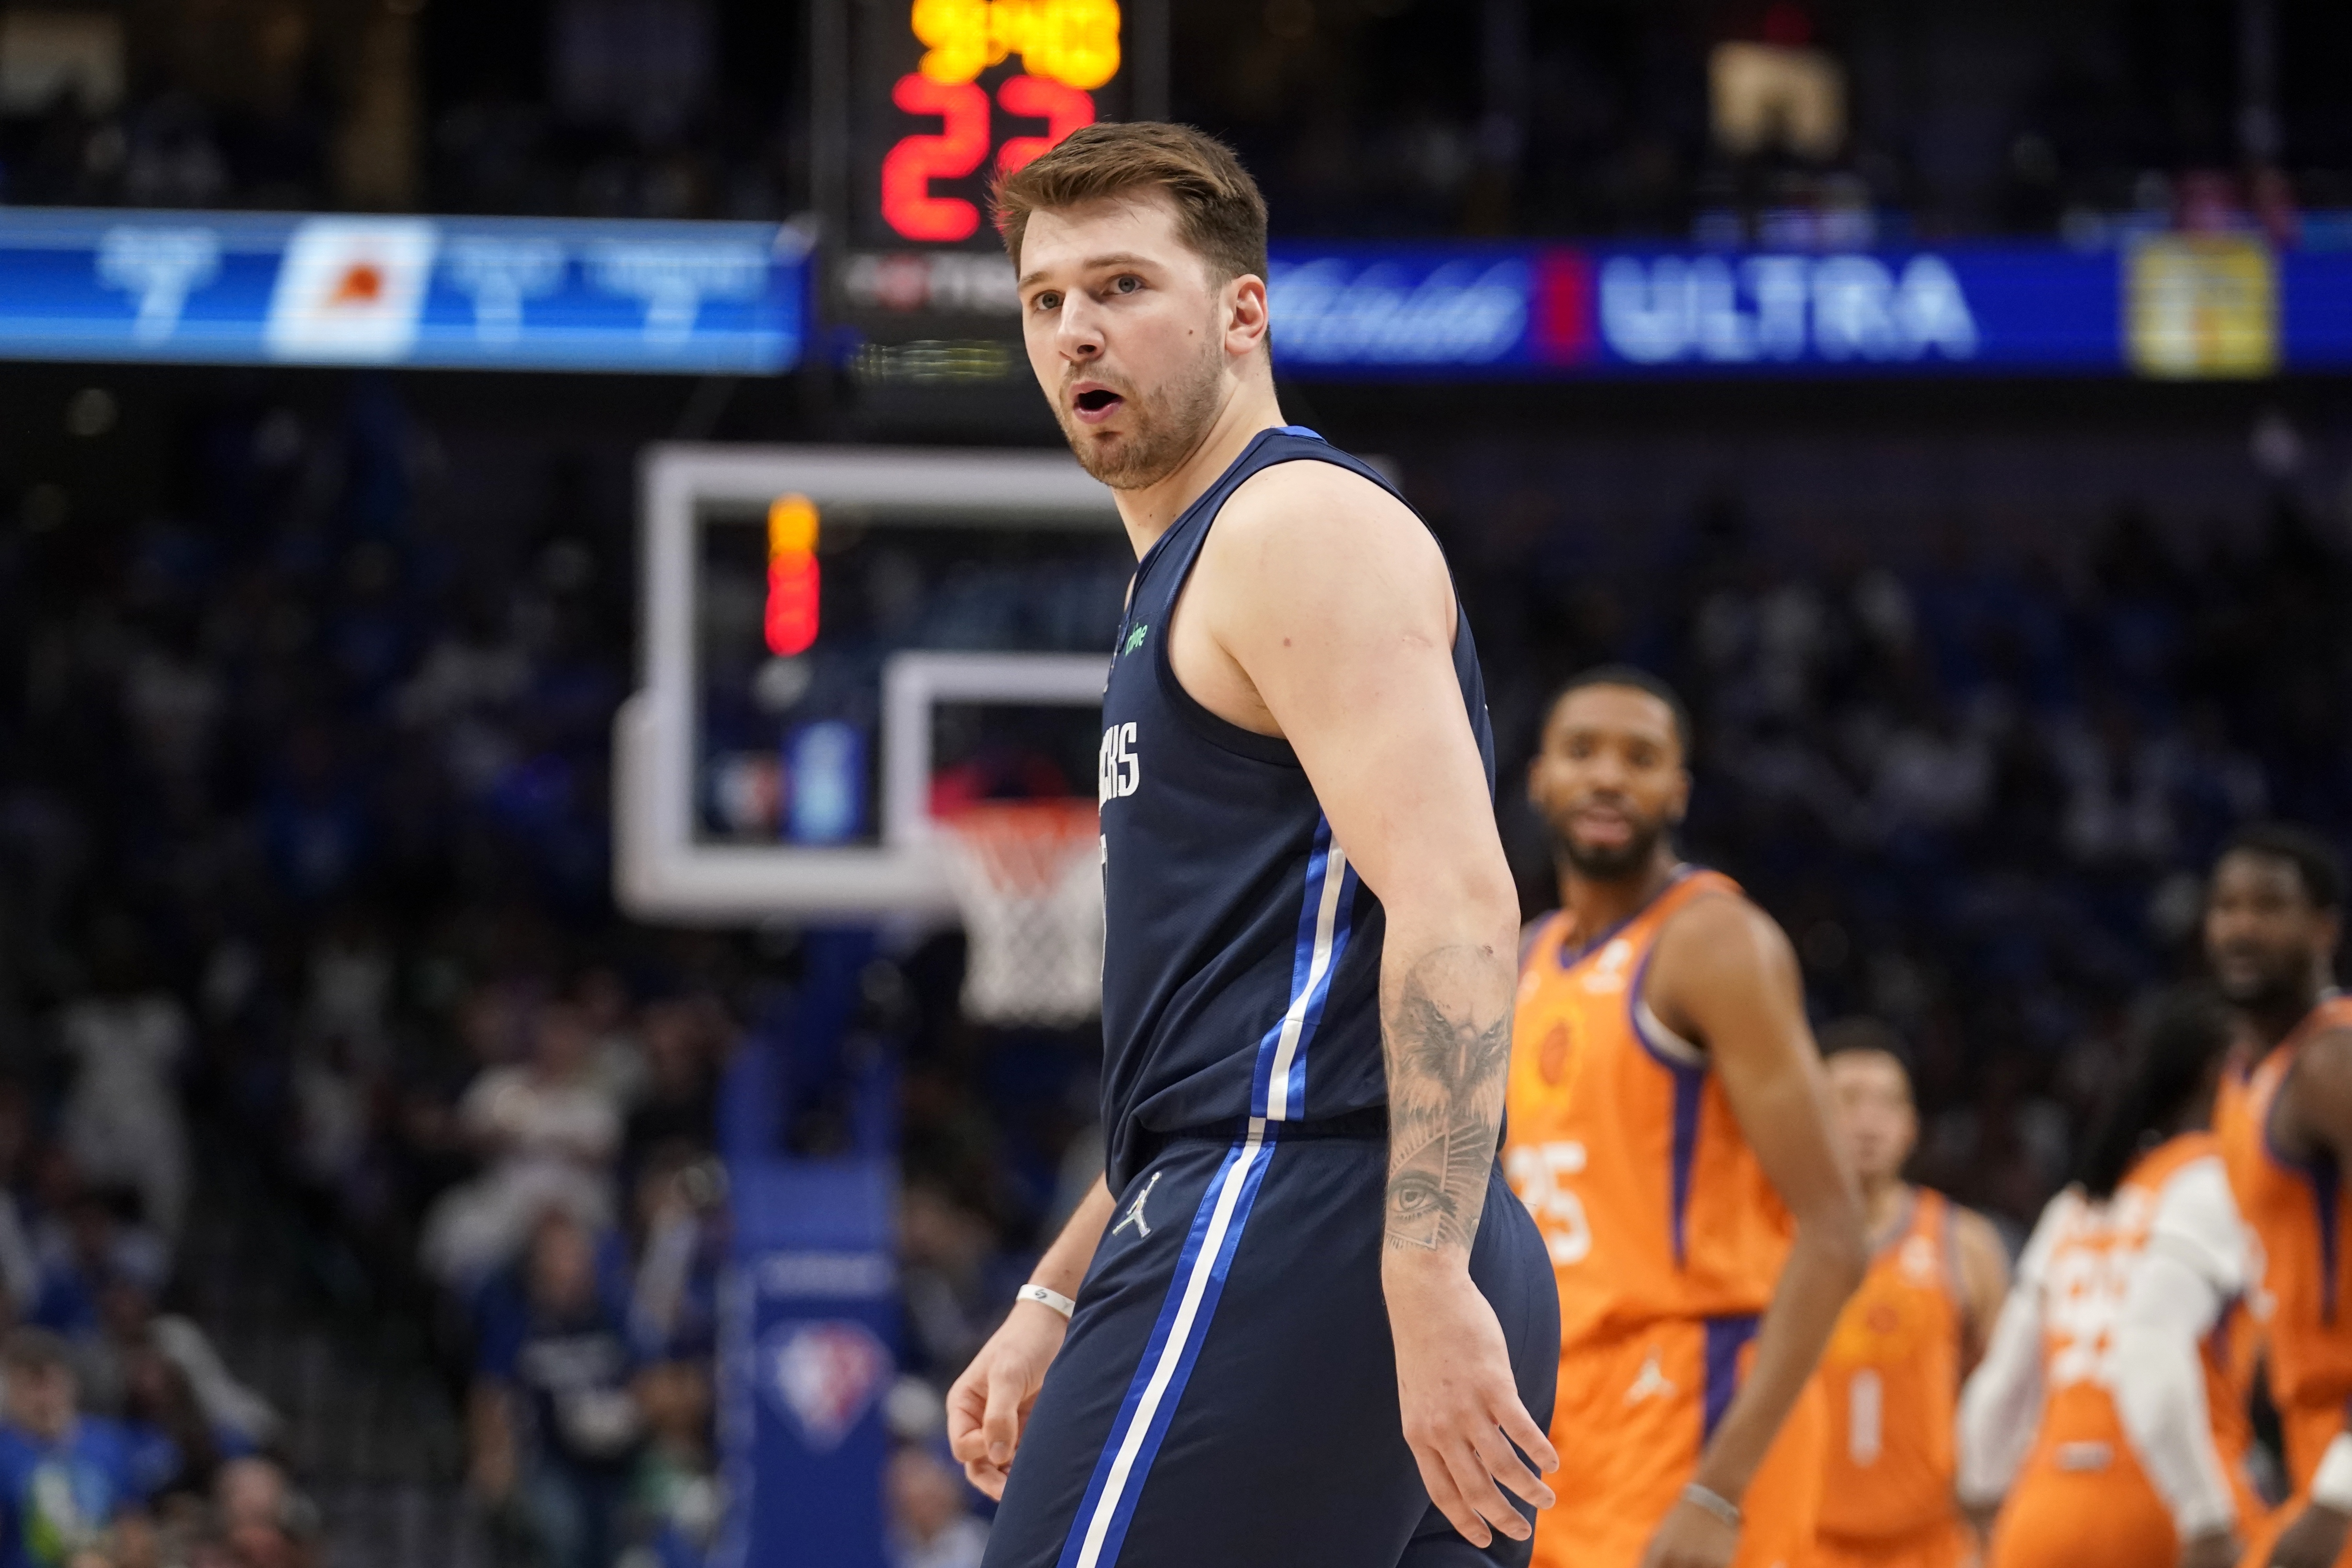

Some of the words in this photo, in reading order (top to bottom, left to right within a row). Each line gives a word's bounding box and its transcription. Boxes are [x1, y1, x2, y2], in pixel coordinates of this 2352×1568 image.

[1599, 254, 1980, 363] ULTRA
[1098, 722, 1140, 811] CKS
[1848, 1366, 1881, 1468] 1
